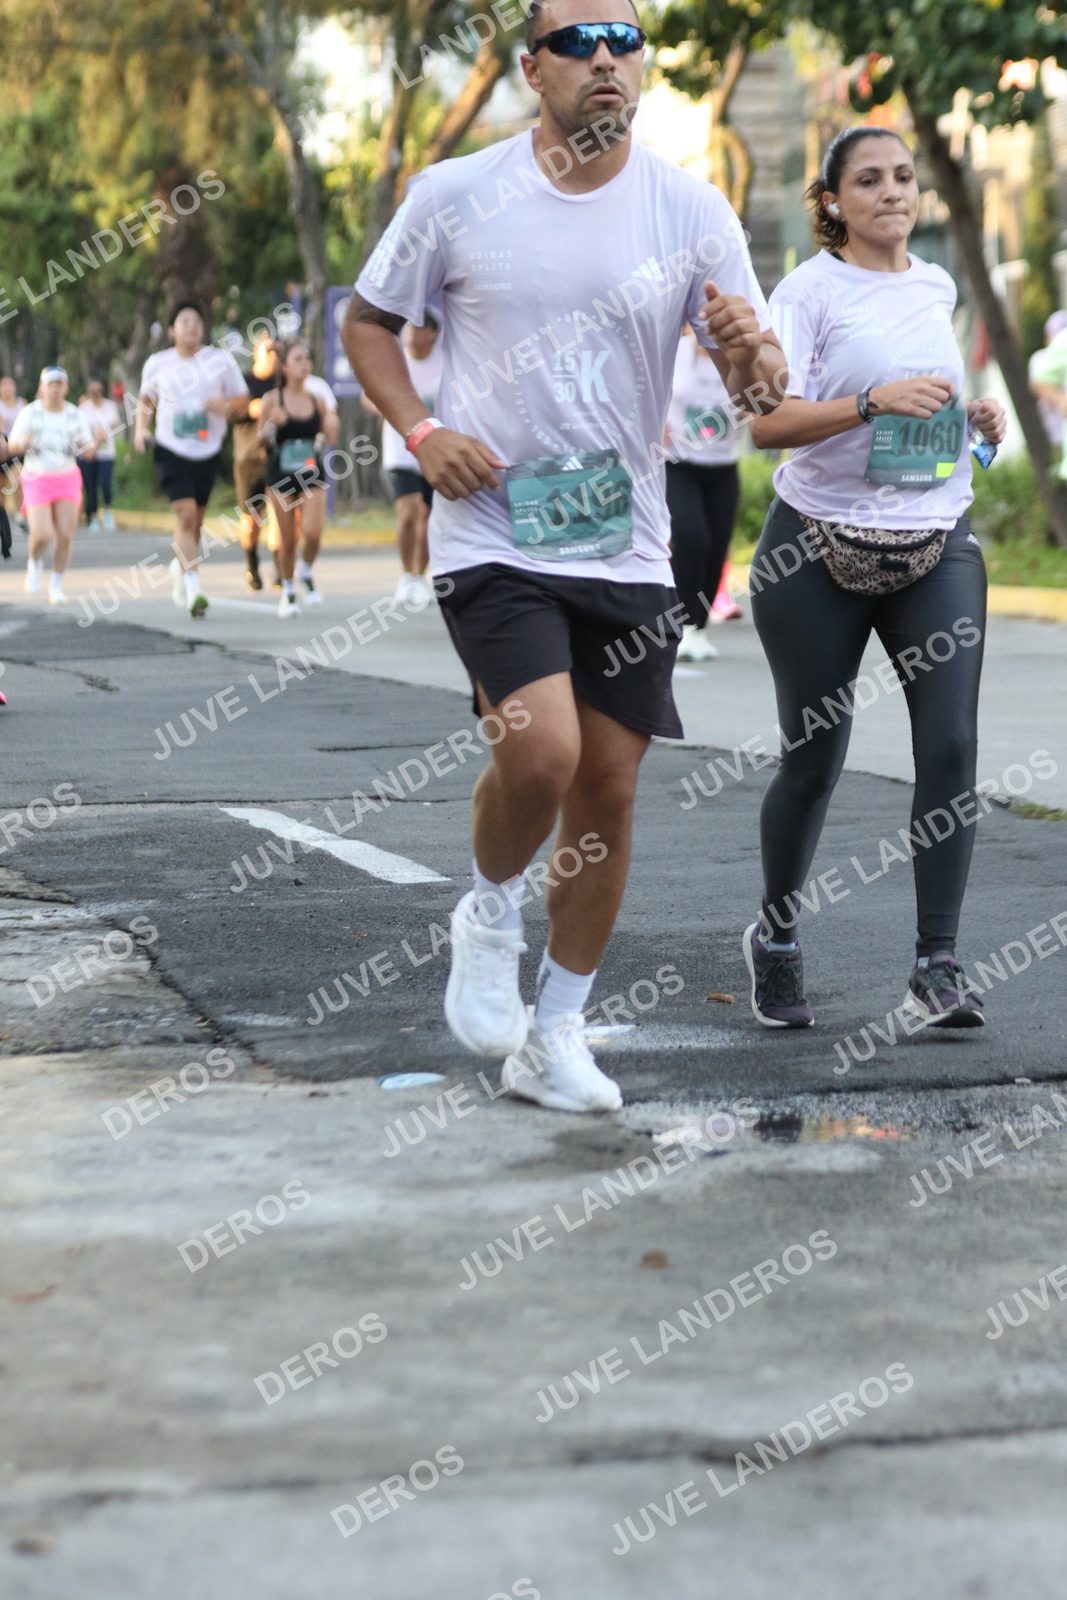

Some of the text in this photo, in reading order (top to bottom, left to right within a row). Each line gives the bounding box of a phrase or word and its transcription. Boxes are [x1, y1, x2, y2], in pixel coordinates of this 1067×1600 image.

[551, 351, 576, 371] 15
[581, 350, 612, 402] K
[553, 381, 576, 404] 30
[896, 420, 961, 456] 1060
[900, 474, 933, 483] SAMSUNG
